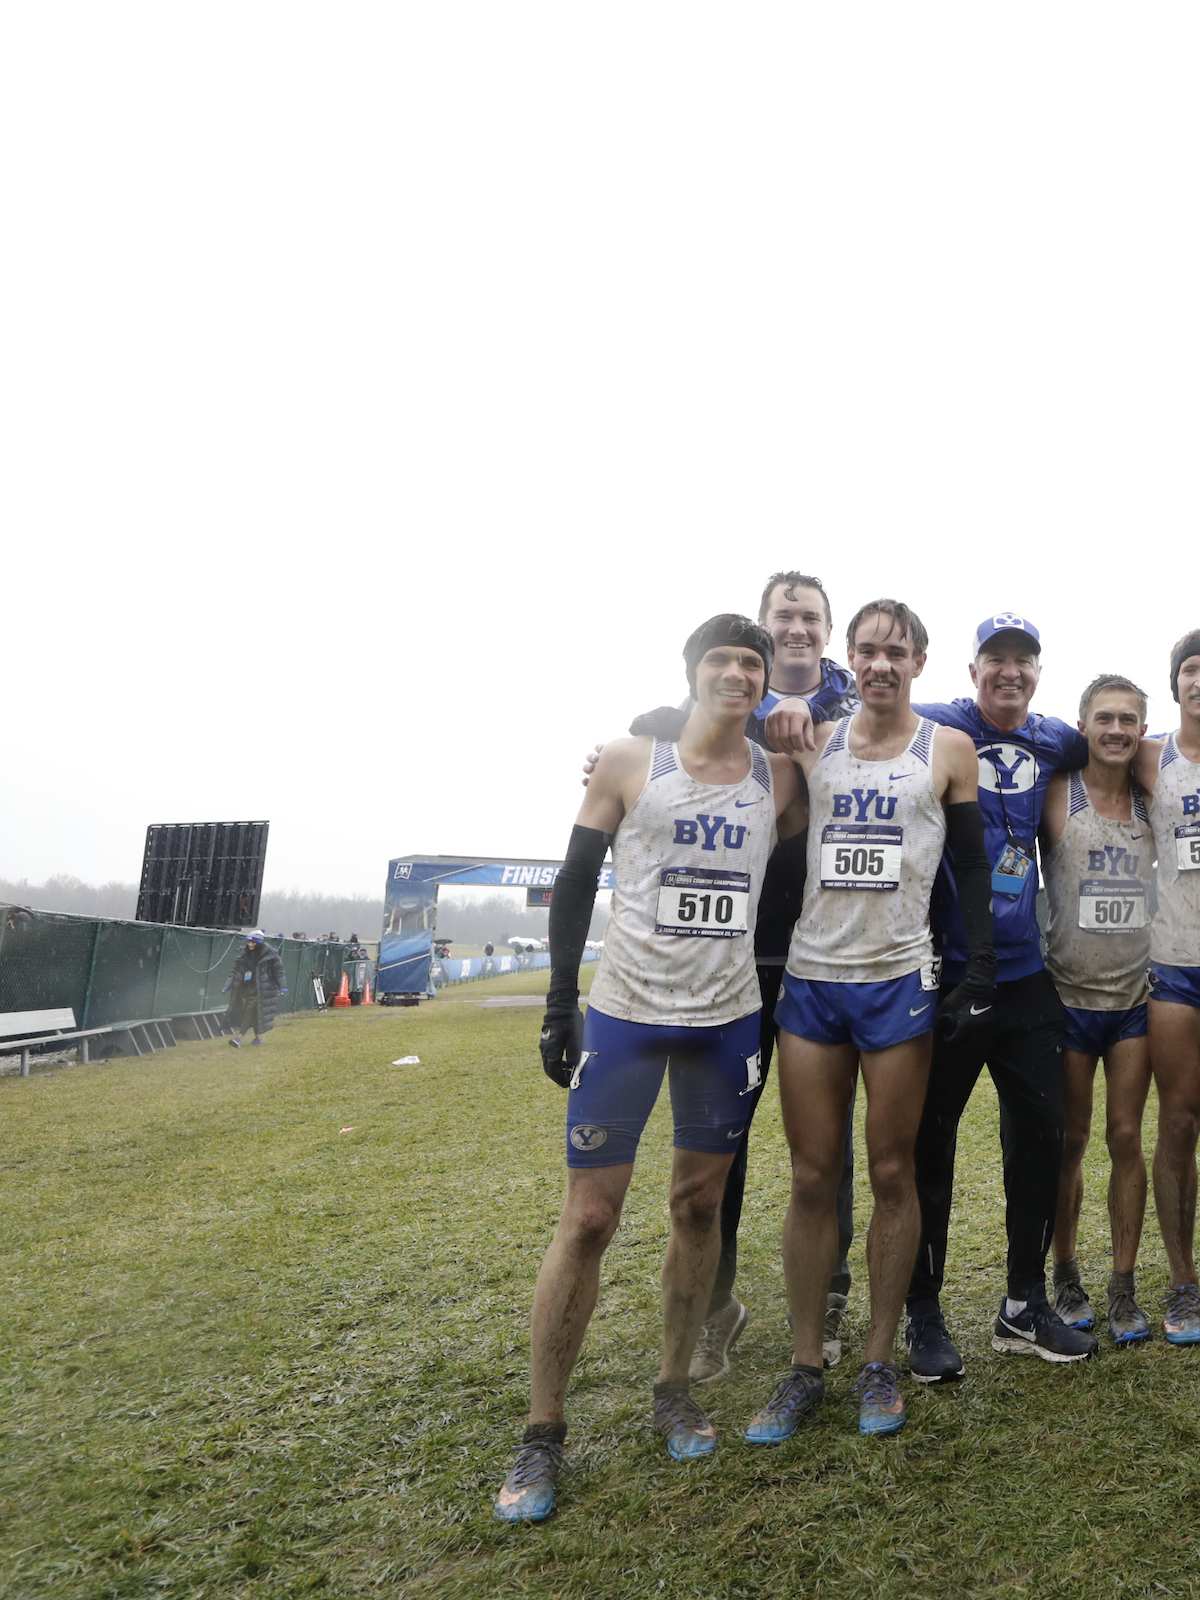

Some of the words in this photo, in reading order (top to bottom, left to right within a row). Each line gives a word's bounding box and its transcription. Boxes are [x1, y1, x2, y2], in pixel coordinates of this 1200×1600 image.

[977, 747, 1031, 789] Y
[832, 789, 898, 822] BYU
[673, 814, 747, 851] BYU
[834, 848, 884, 876] 505
[1088, 845, 1139, 876] BYU
[501, 866, 560, 886] FINIS
[676, 876, 692, 884] CROSS
[693, 877, 713, 885] COUNTRY
[714, 880, 749, 888] CHAMPIONSHIPS
[678, 893, 733, 924] 510
[1095, 900, 1135, 924] 507
[575, 1129, 598, 1147] Y
